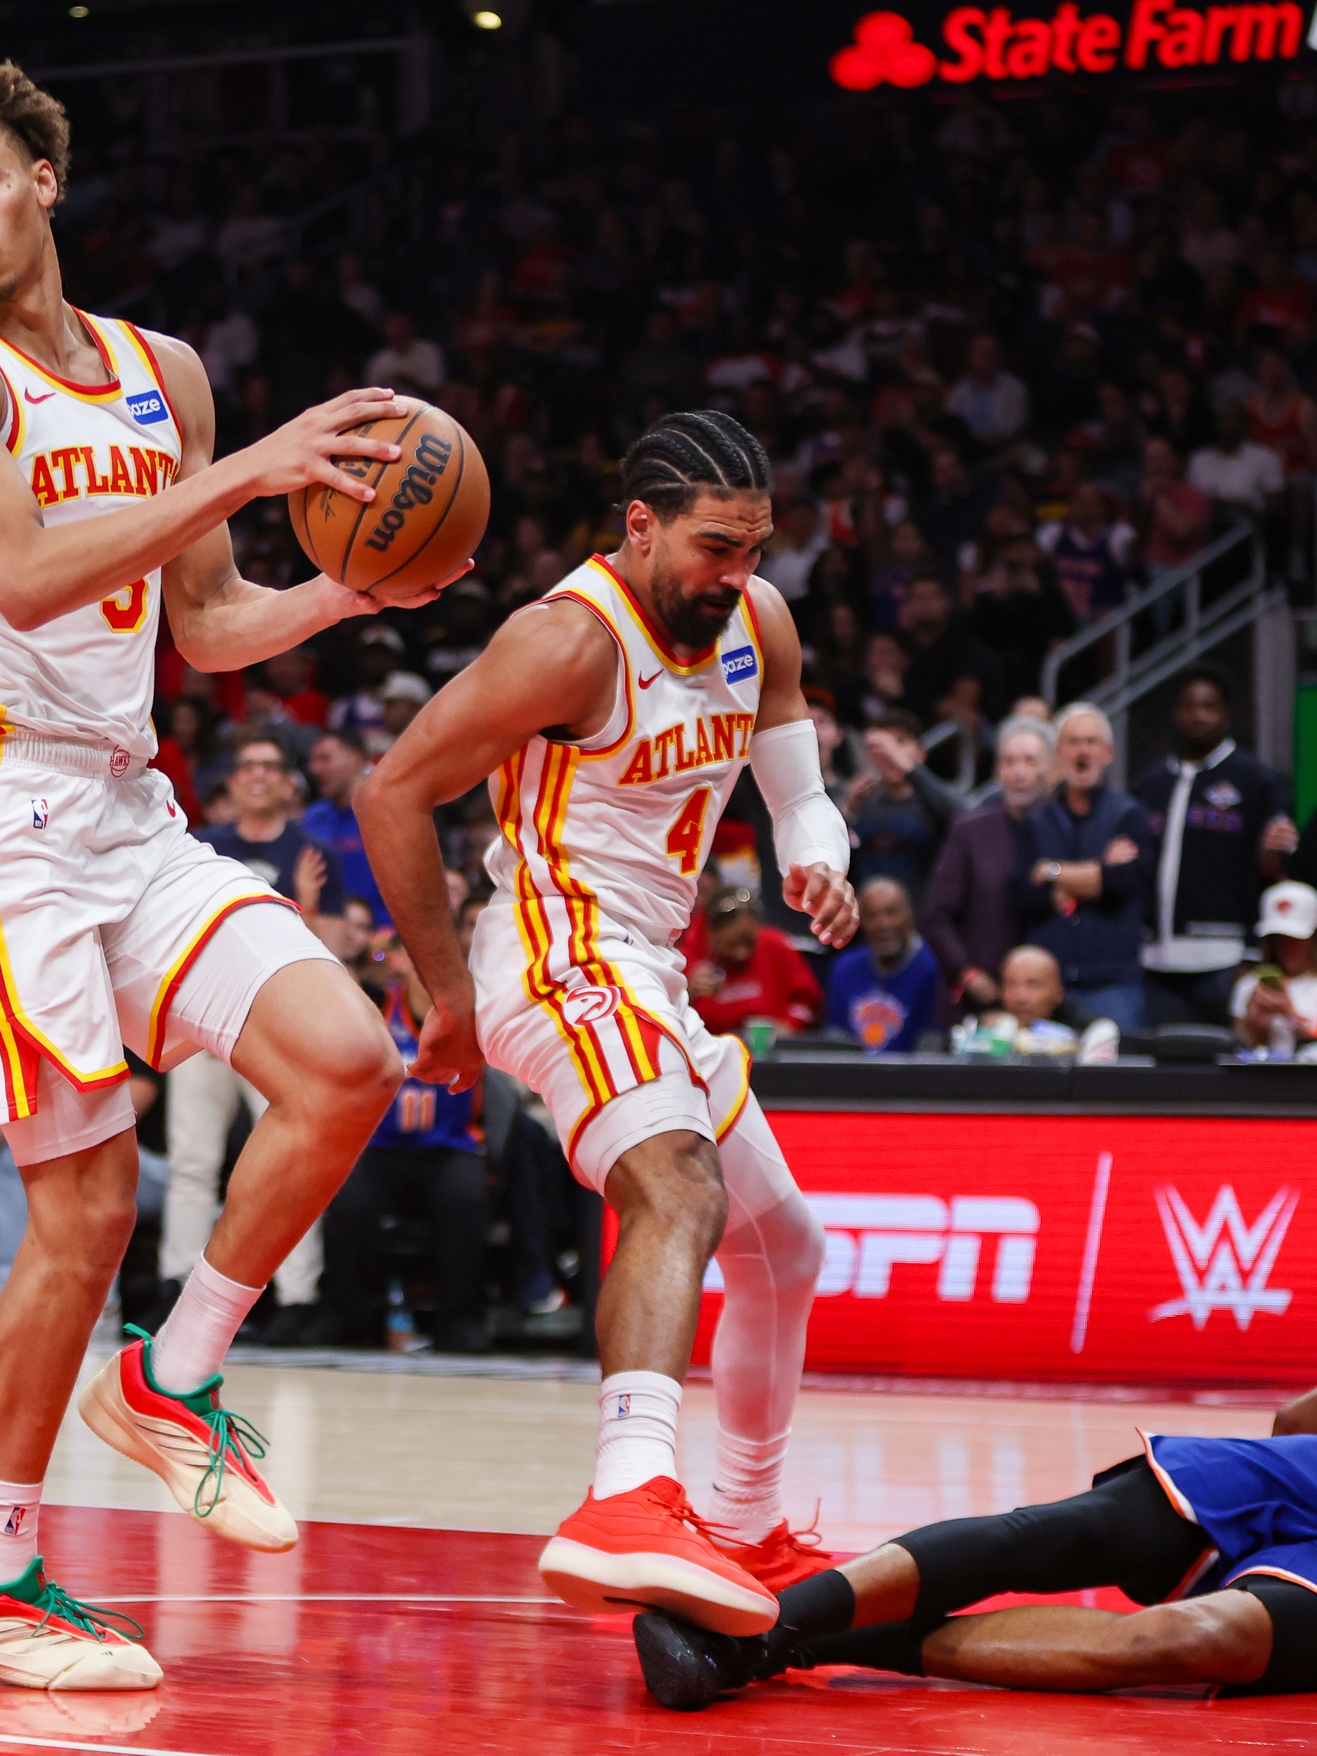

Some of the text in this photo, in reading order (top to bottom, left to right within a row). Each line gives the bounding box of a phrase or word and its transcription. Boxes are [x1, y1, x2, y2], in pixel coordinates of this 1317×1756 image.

[940, 3, 1121, 84] State
[1124, 0, 1303, 69] Farm
[128, 398, 161, 416] aze
[31, 444, 179, 508] ATLANT
[364, 433, 453, 552] Wilson
[665, 785, 712, 877] 4
[703, 1193, 1041, 1303] SPN
